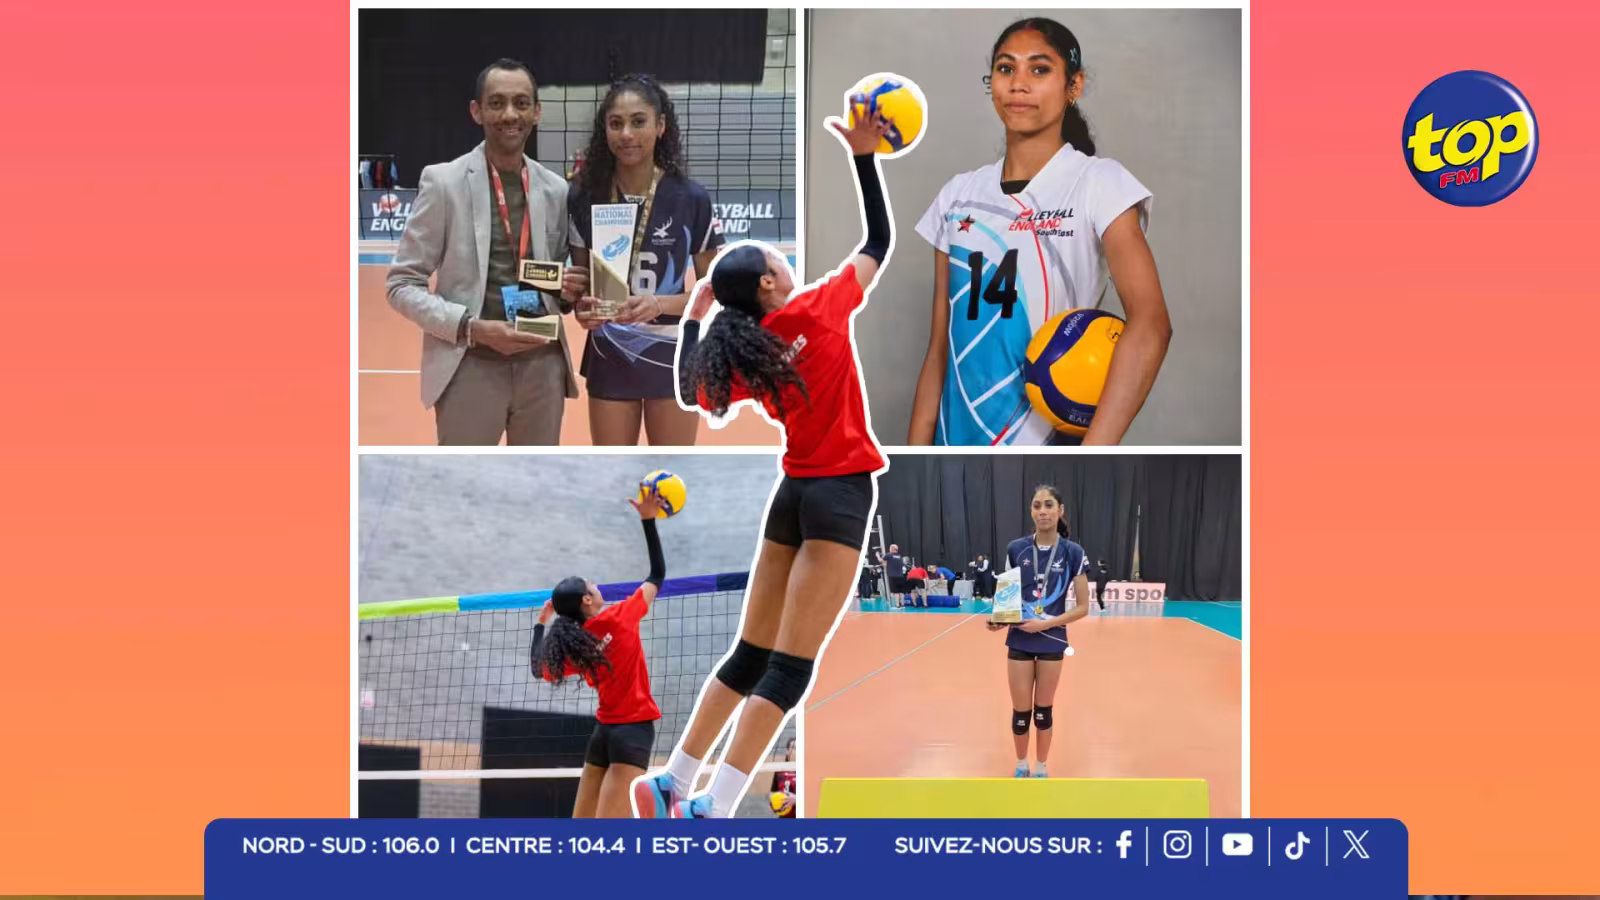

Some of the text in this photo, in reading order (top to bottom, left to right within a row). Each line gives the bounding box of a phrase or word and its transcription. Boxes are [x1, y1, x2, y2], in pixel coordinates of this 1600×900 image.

[594, 209, 632, 219] NATIONAL
[631, 251, 658, 296] 6
[967, 248, 1018, 321] 14
